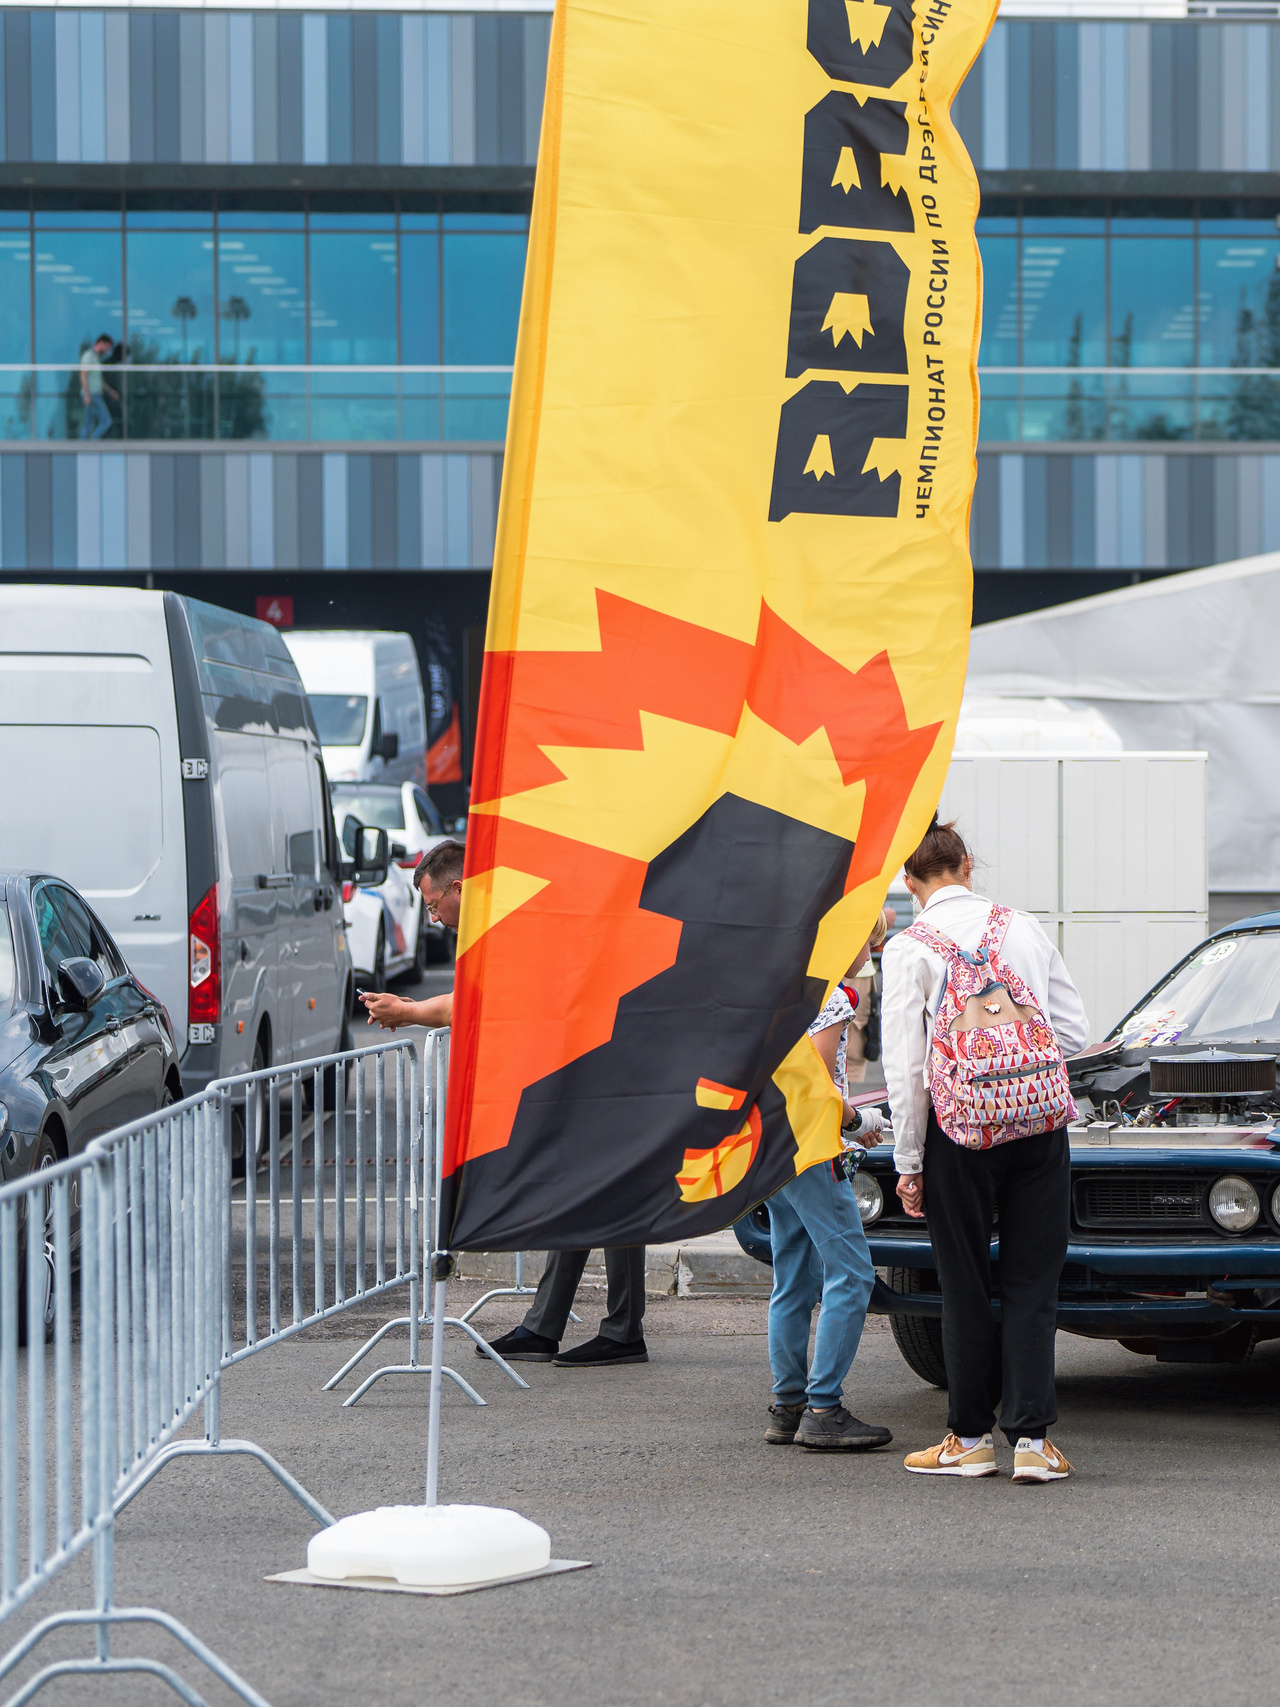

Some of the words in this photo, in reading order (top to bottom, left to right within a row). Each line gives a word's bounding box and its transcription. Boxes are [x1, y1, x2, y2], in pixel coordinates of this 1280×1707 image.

[921, 195, 943, 228] ПО
[923, 239, 950, 345] РОССИИ
[916, 354, 946, 519] ЧЕМПИОНАТ
[267, 600, 282, 622] 4
